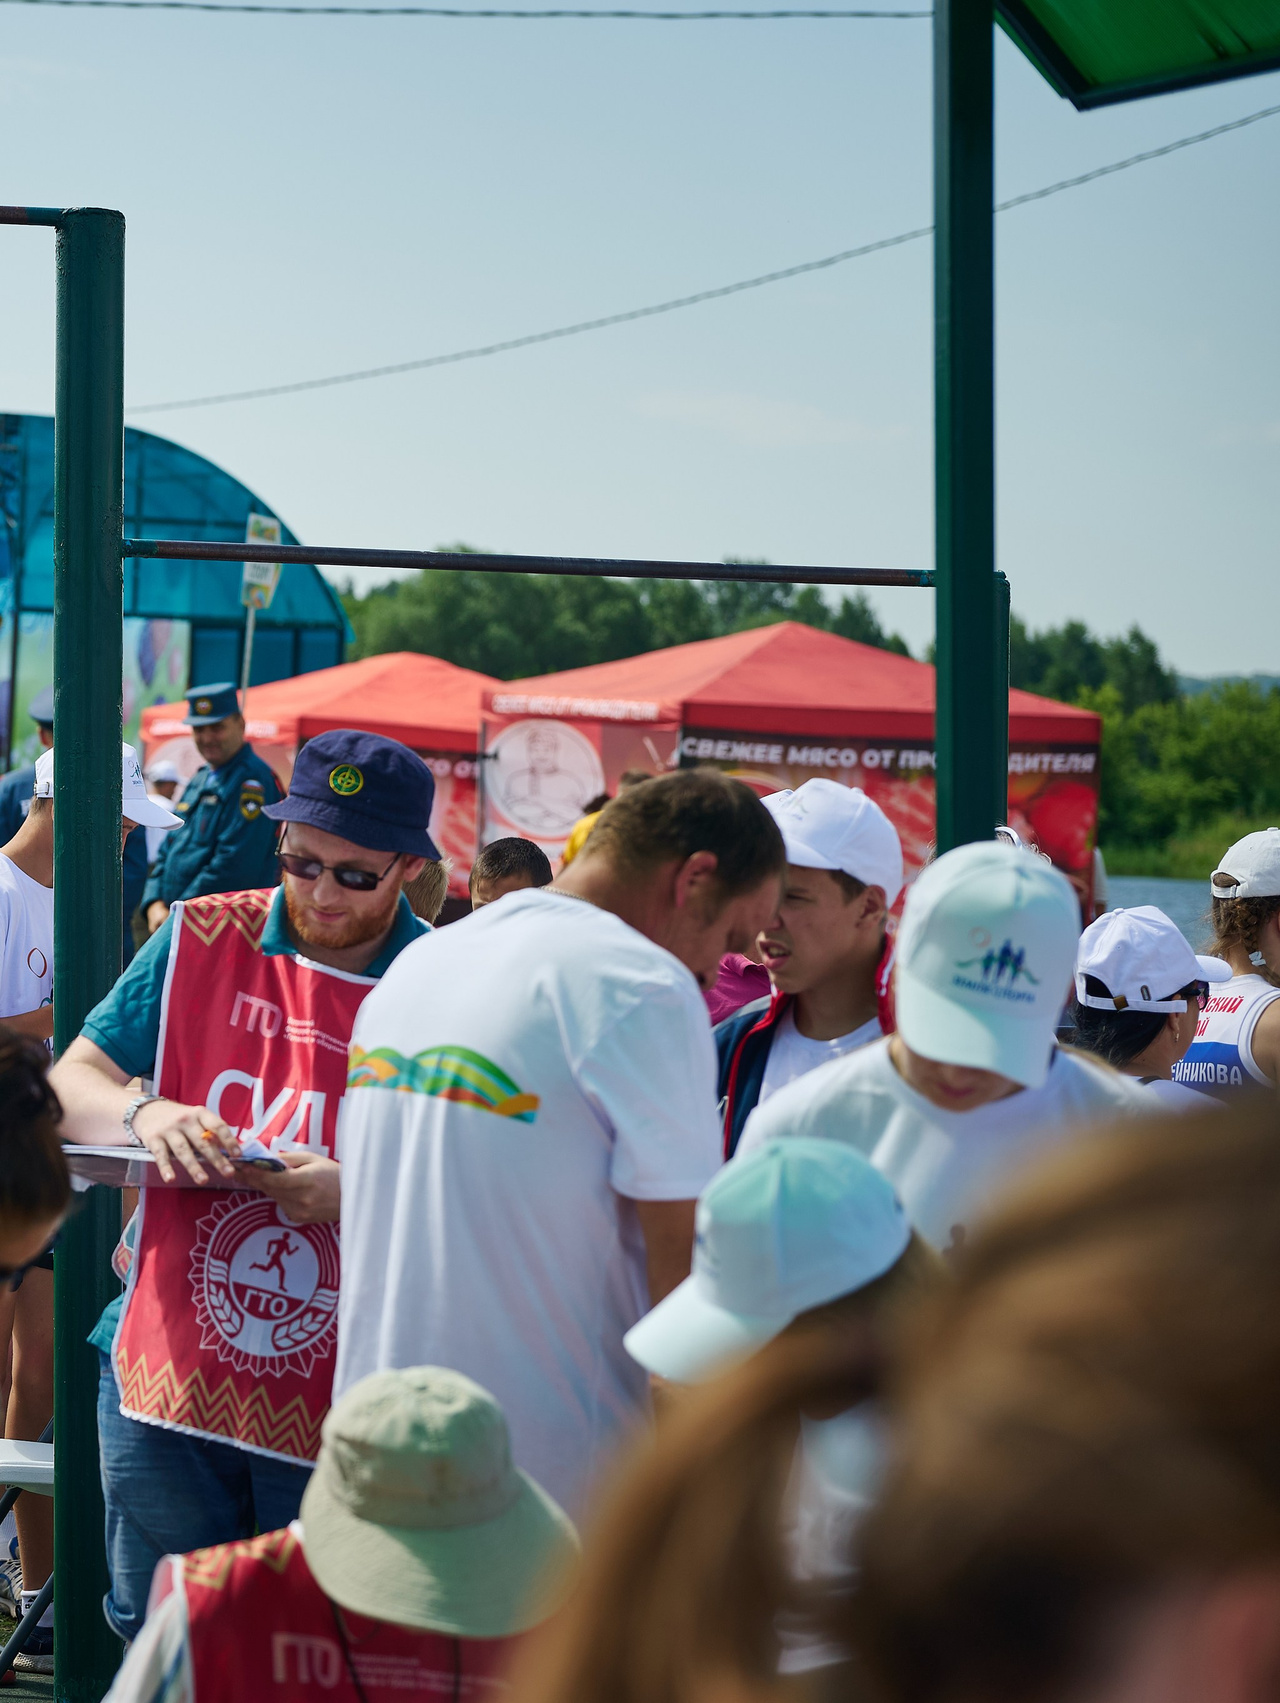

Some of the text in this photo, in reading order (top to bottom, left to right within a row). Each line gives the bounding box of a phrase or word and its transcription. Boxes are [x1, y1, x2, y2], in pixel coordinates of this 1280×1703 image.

[682, 736, 784, 764] СВЕЖЕЕ
[787, 745, 859, 769] МЯСО
[861, 748, 896, 769] ОТ
[1201, 994, 1245, 1014] СКИЙ
[206, 1069, 345, 1162] СУД
[243, 1287, 288, 1318] ГТО
